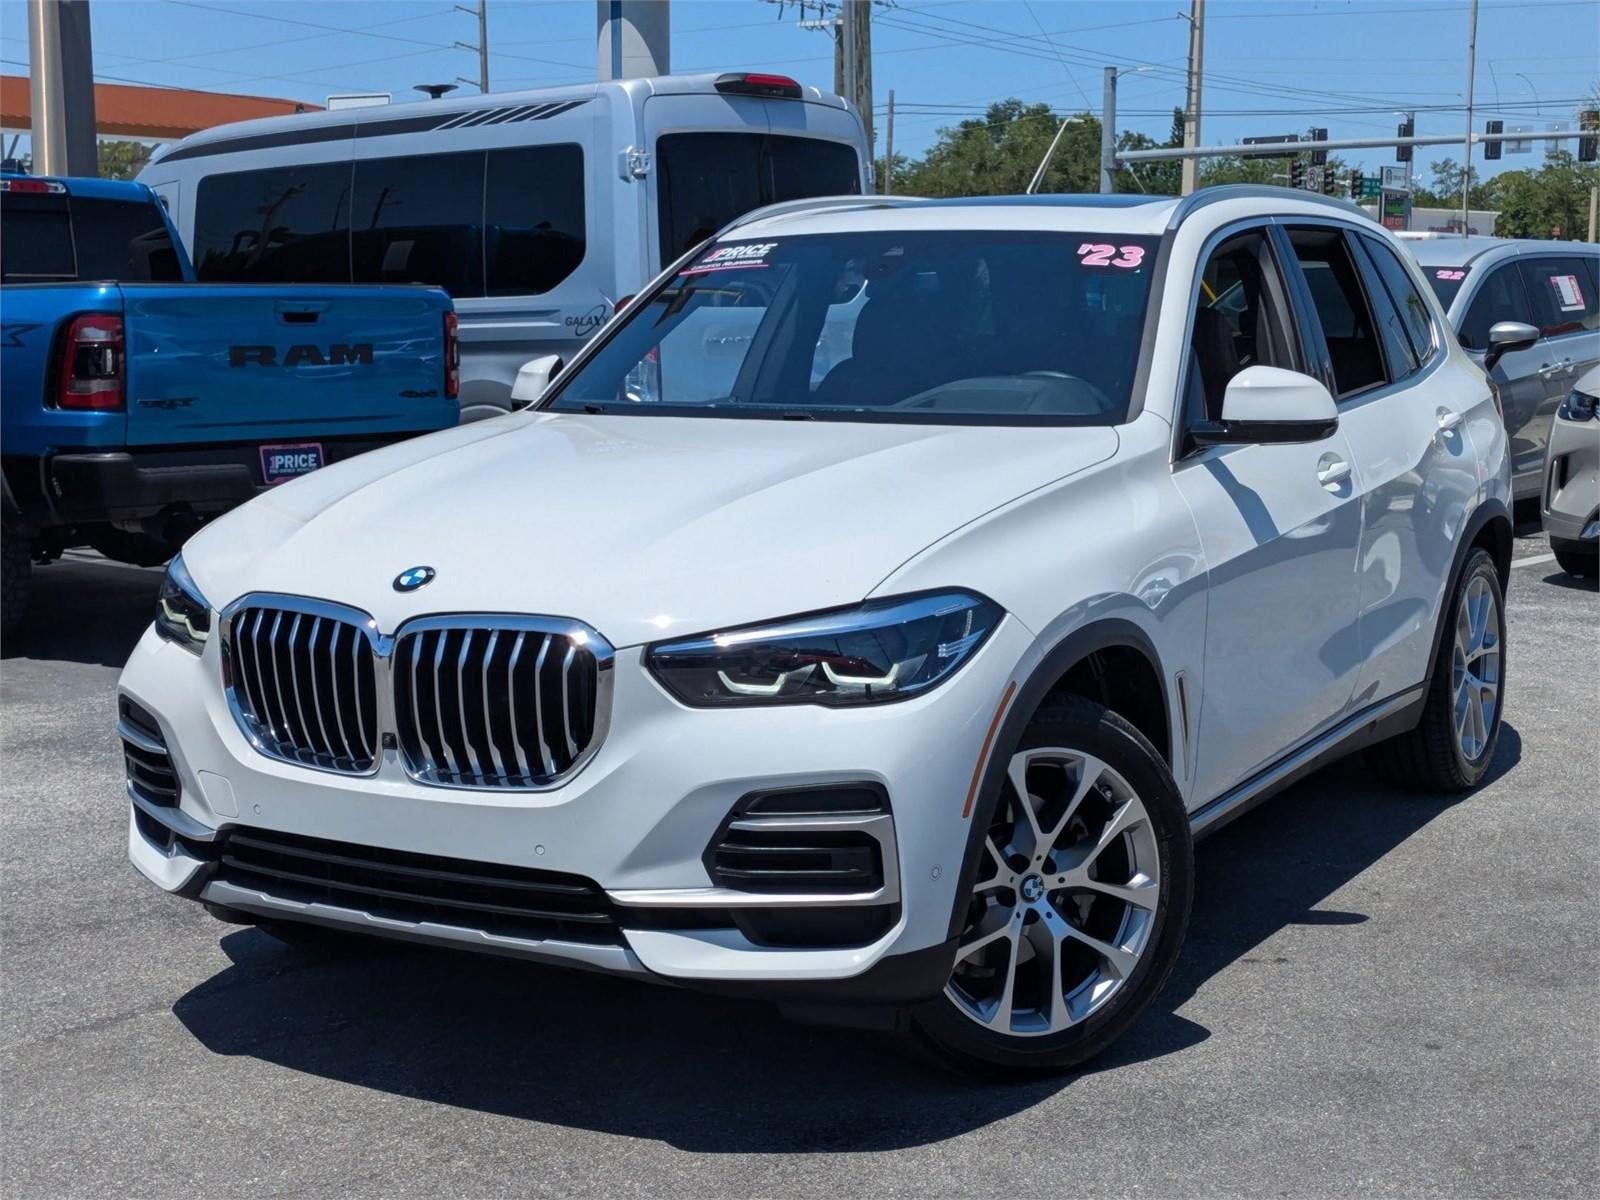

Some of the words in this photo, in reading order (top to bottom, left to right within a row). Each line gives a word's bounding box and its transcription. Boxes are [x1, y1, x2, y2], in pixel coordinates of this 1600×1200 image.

[1076, 243, 1145, 268] '23
[564, 315, 610, 327] GALAXY
[229, 343, 374, 368] RAM
